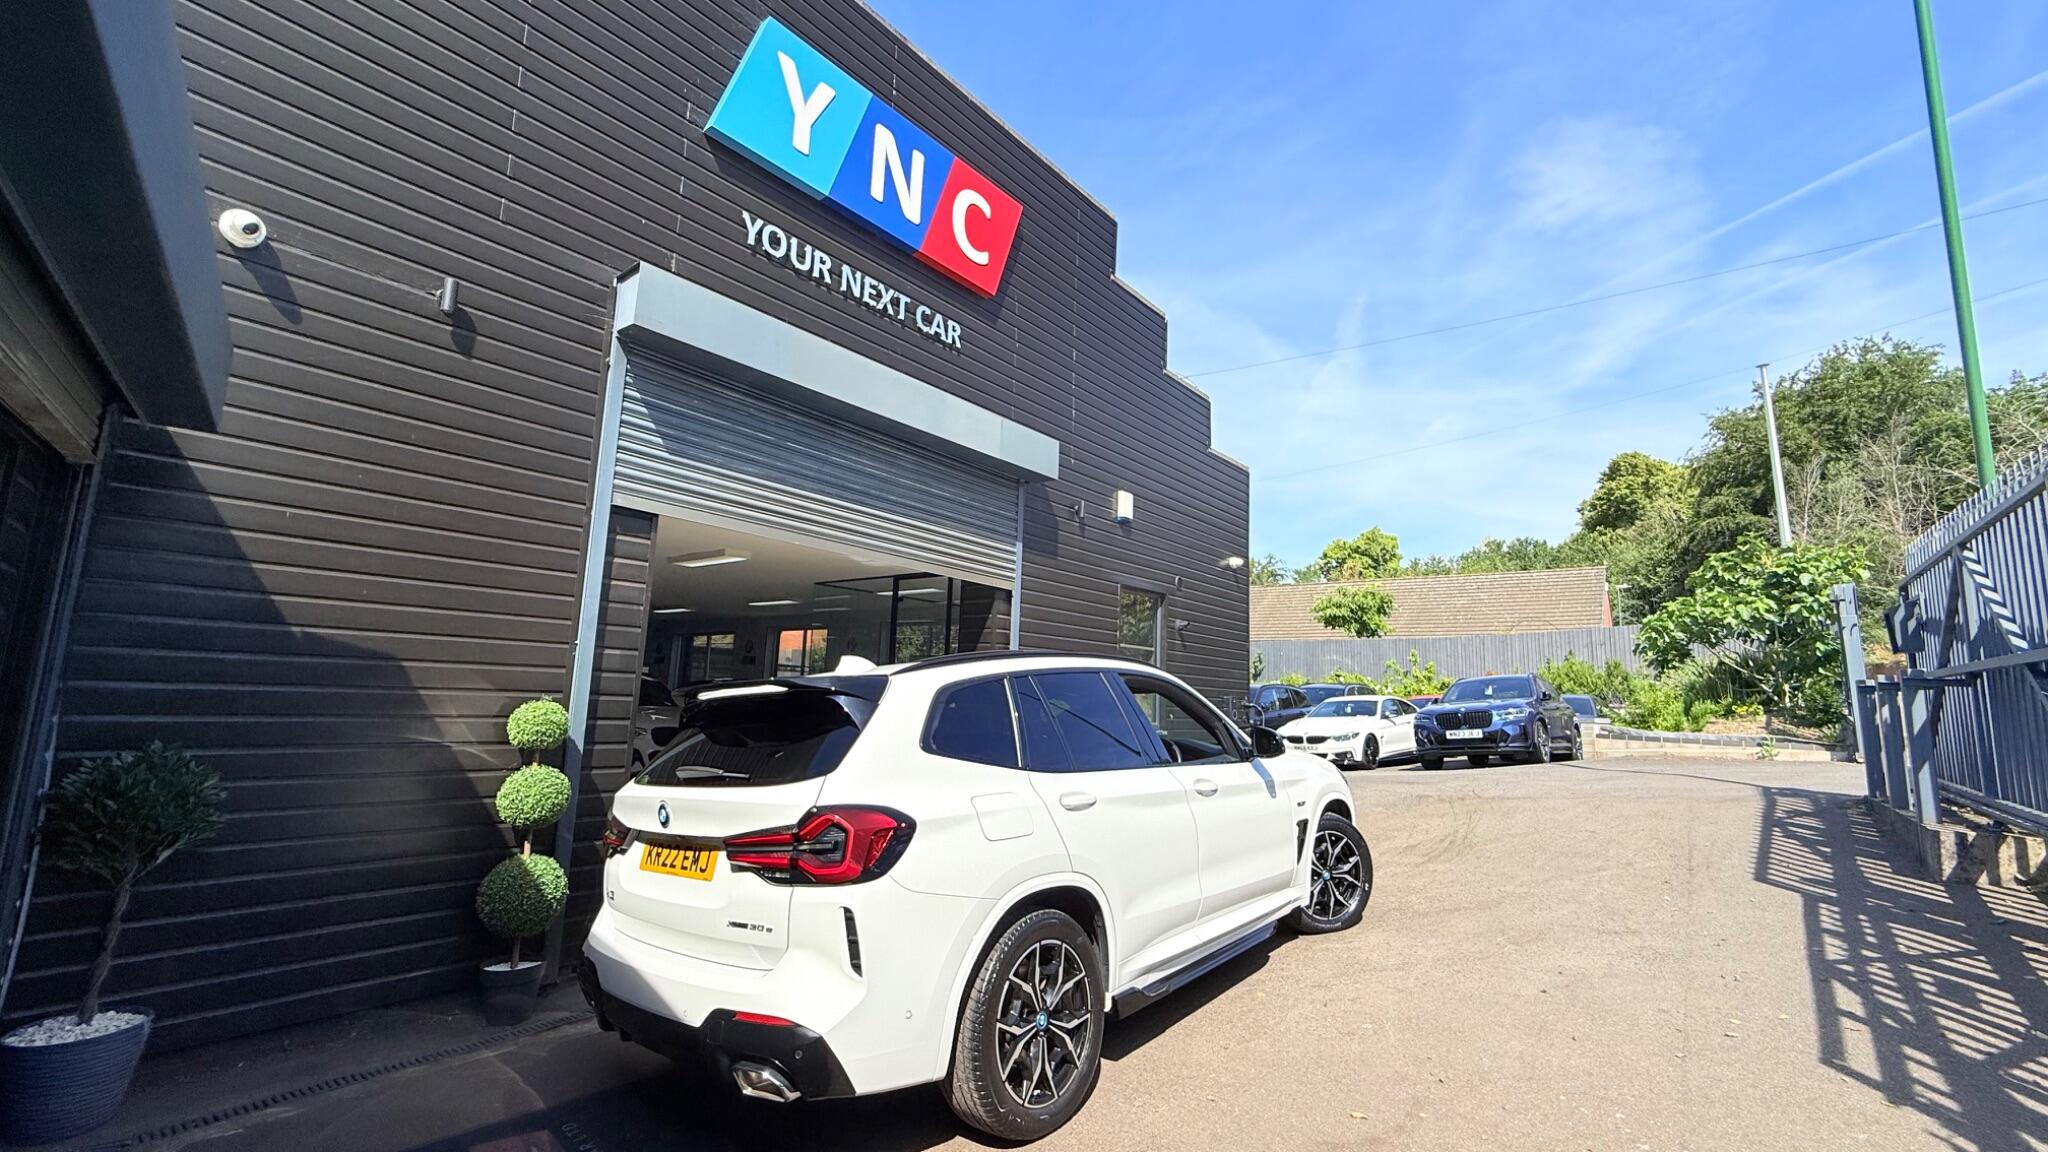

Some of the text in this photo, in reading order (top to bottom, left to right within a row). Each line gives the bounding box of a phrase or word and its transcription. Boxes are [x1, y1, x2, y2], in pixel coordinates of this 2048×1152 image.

[777, 50, 992, 266] YNC
[742, 210, 962, 348] YOUR NEXT CAR
[645, 841, 712, 872] KR22 EMJ
